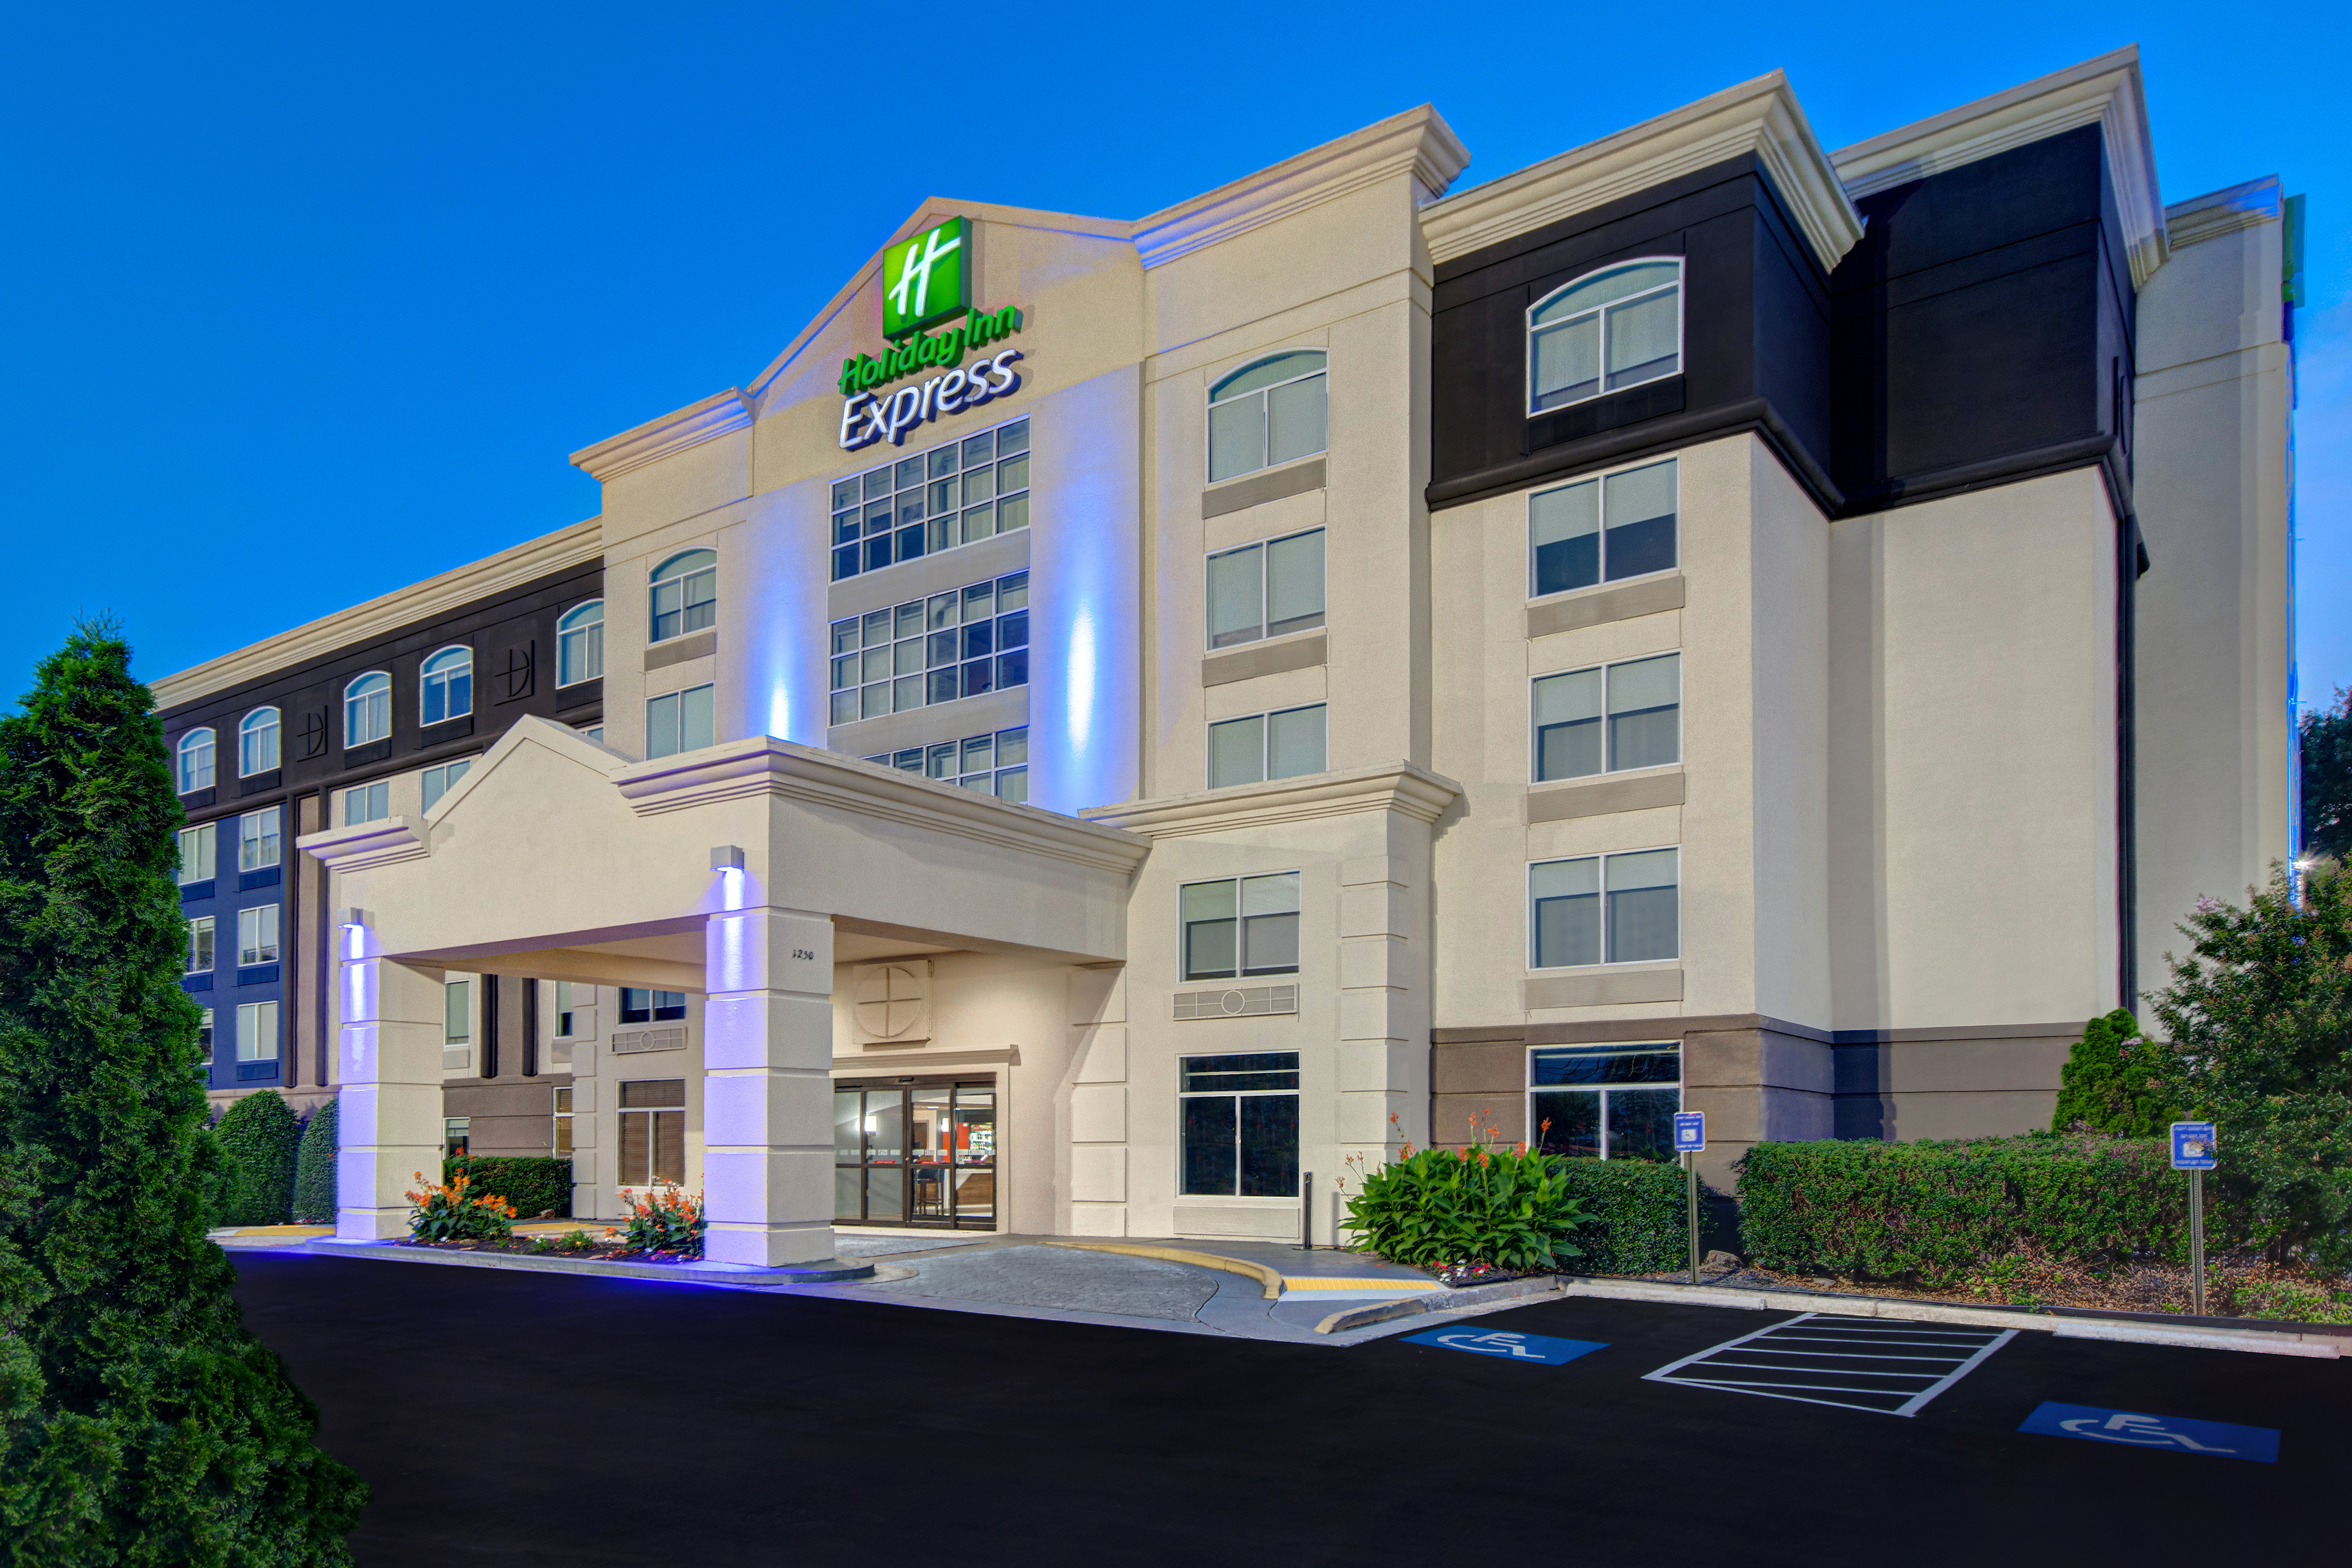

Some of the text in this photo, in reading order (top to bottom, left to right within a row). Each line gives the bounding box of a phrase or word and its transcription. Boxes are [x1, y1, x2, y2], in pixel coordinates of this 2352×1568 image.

[838, 305, 1020, 394] Holiday Inn
[838, 348, 1020, 449] Express
[792, 949, 814, 960] 1250
